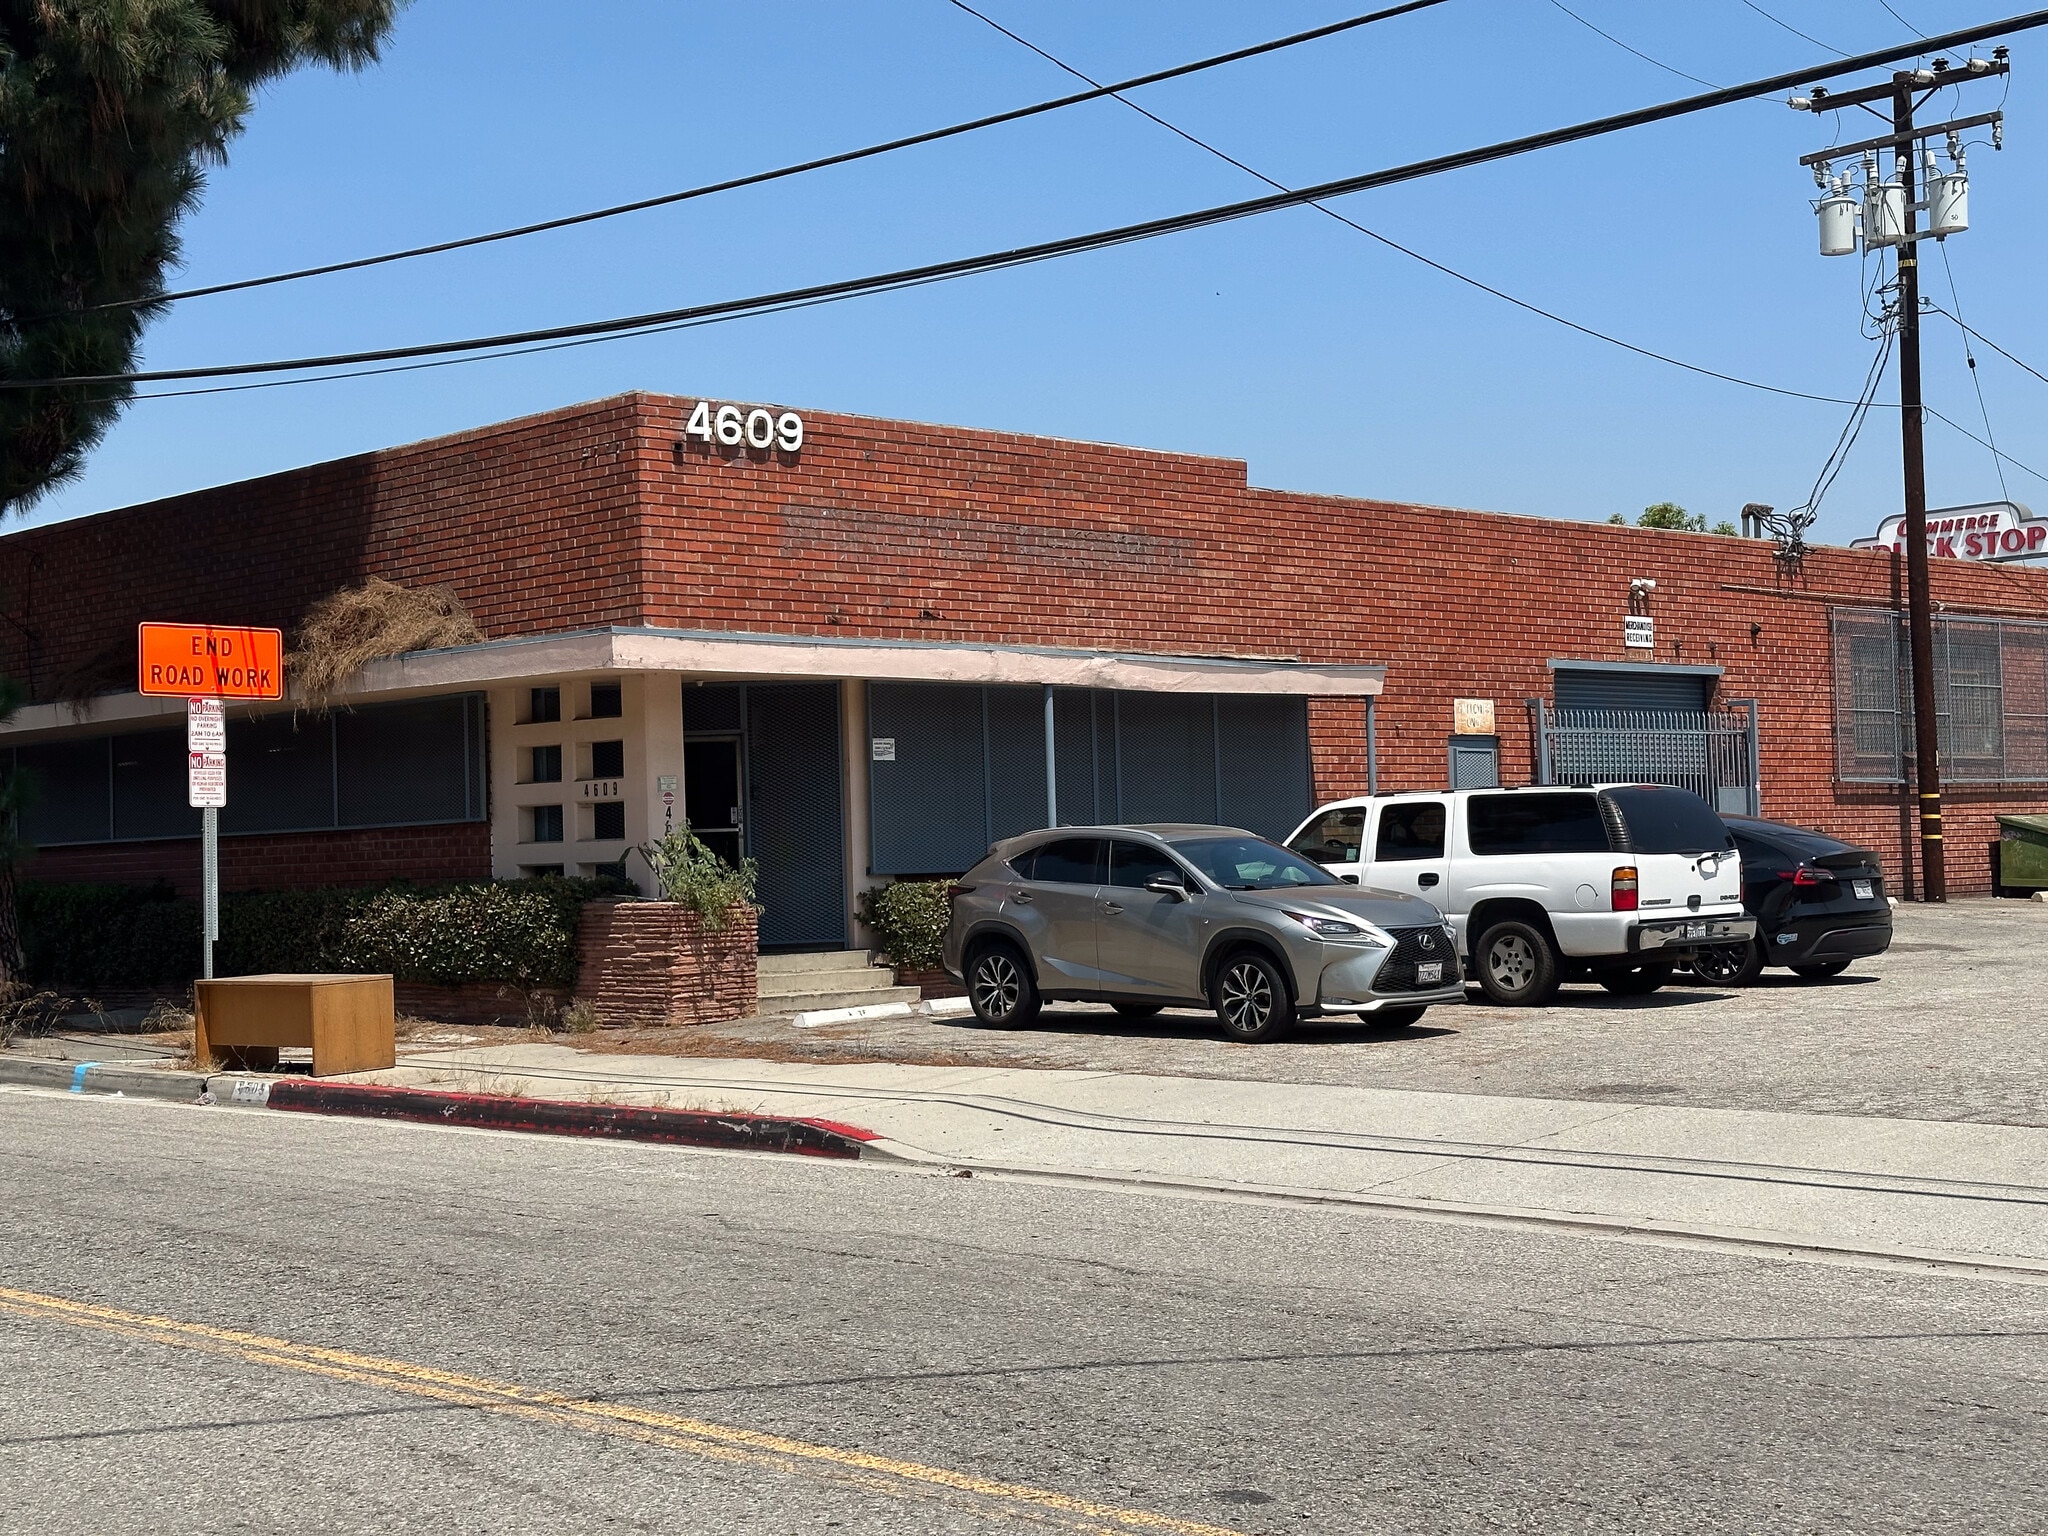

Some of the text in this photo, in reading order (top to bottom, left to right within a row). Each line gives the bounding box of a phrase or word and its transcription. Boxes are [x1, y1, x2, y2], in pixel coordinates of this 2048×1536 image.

[685, 401, 804, 452] 4609
[1897, 513, 2000, 538] CMMERCE
[1965, 526, 2047, 557] STOP
[191, 636, 233, 657] END
[1626, 633, 1653, 643] RECEIVING
[151, 664, 271, 688] ROAD WORK
[190, 701, 224, 714] NO PARKING
[191, 756, 202, 769] NO
[584, 781, 618, 797] 4609
